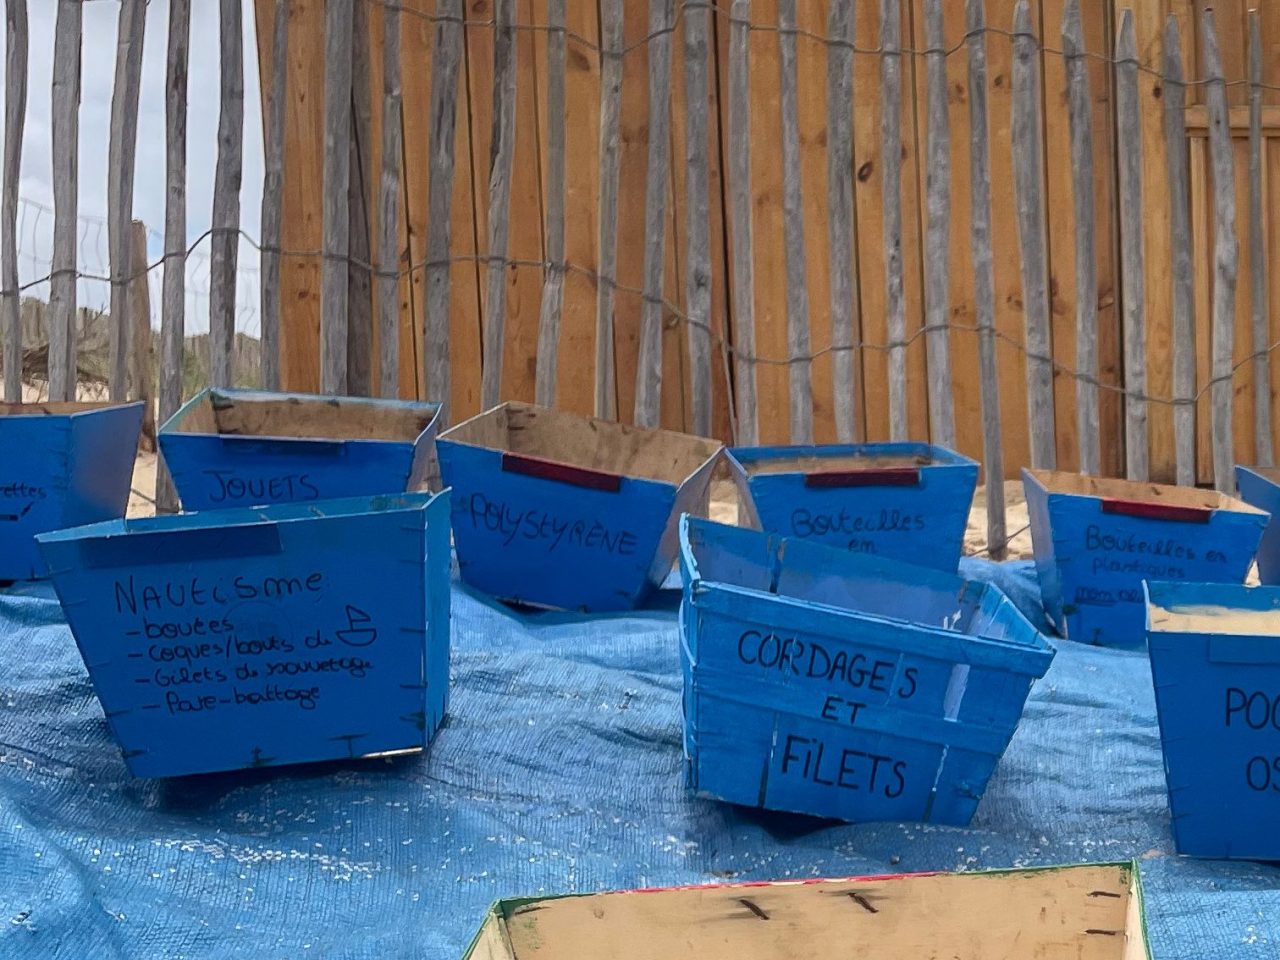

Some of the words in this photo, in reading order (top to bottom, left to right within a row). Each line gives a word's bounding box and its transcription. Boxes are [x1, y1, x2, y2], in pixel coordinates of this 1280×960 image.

[201, 469, 319, 503] JOUETS
[737, 629, 919, 699] CORDAGES
[821, 696, 867, 725] ET
